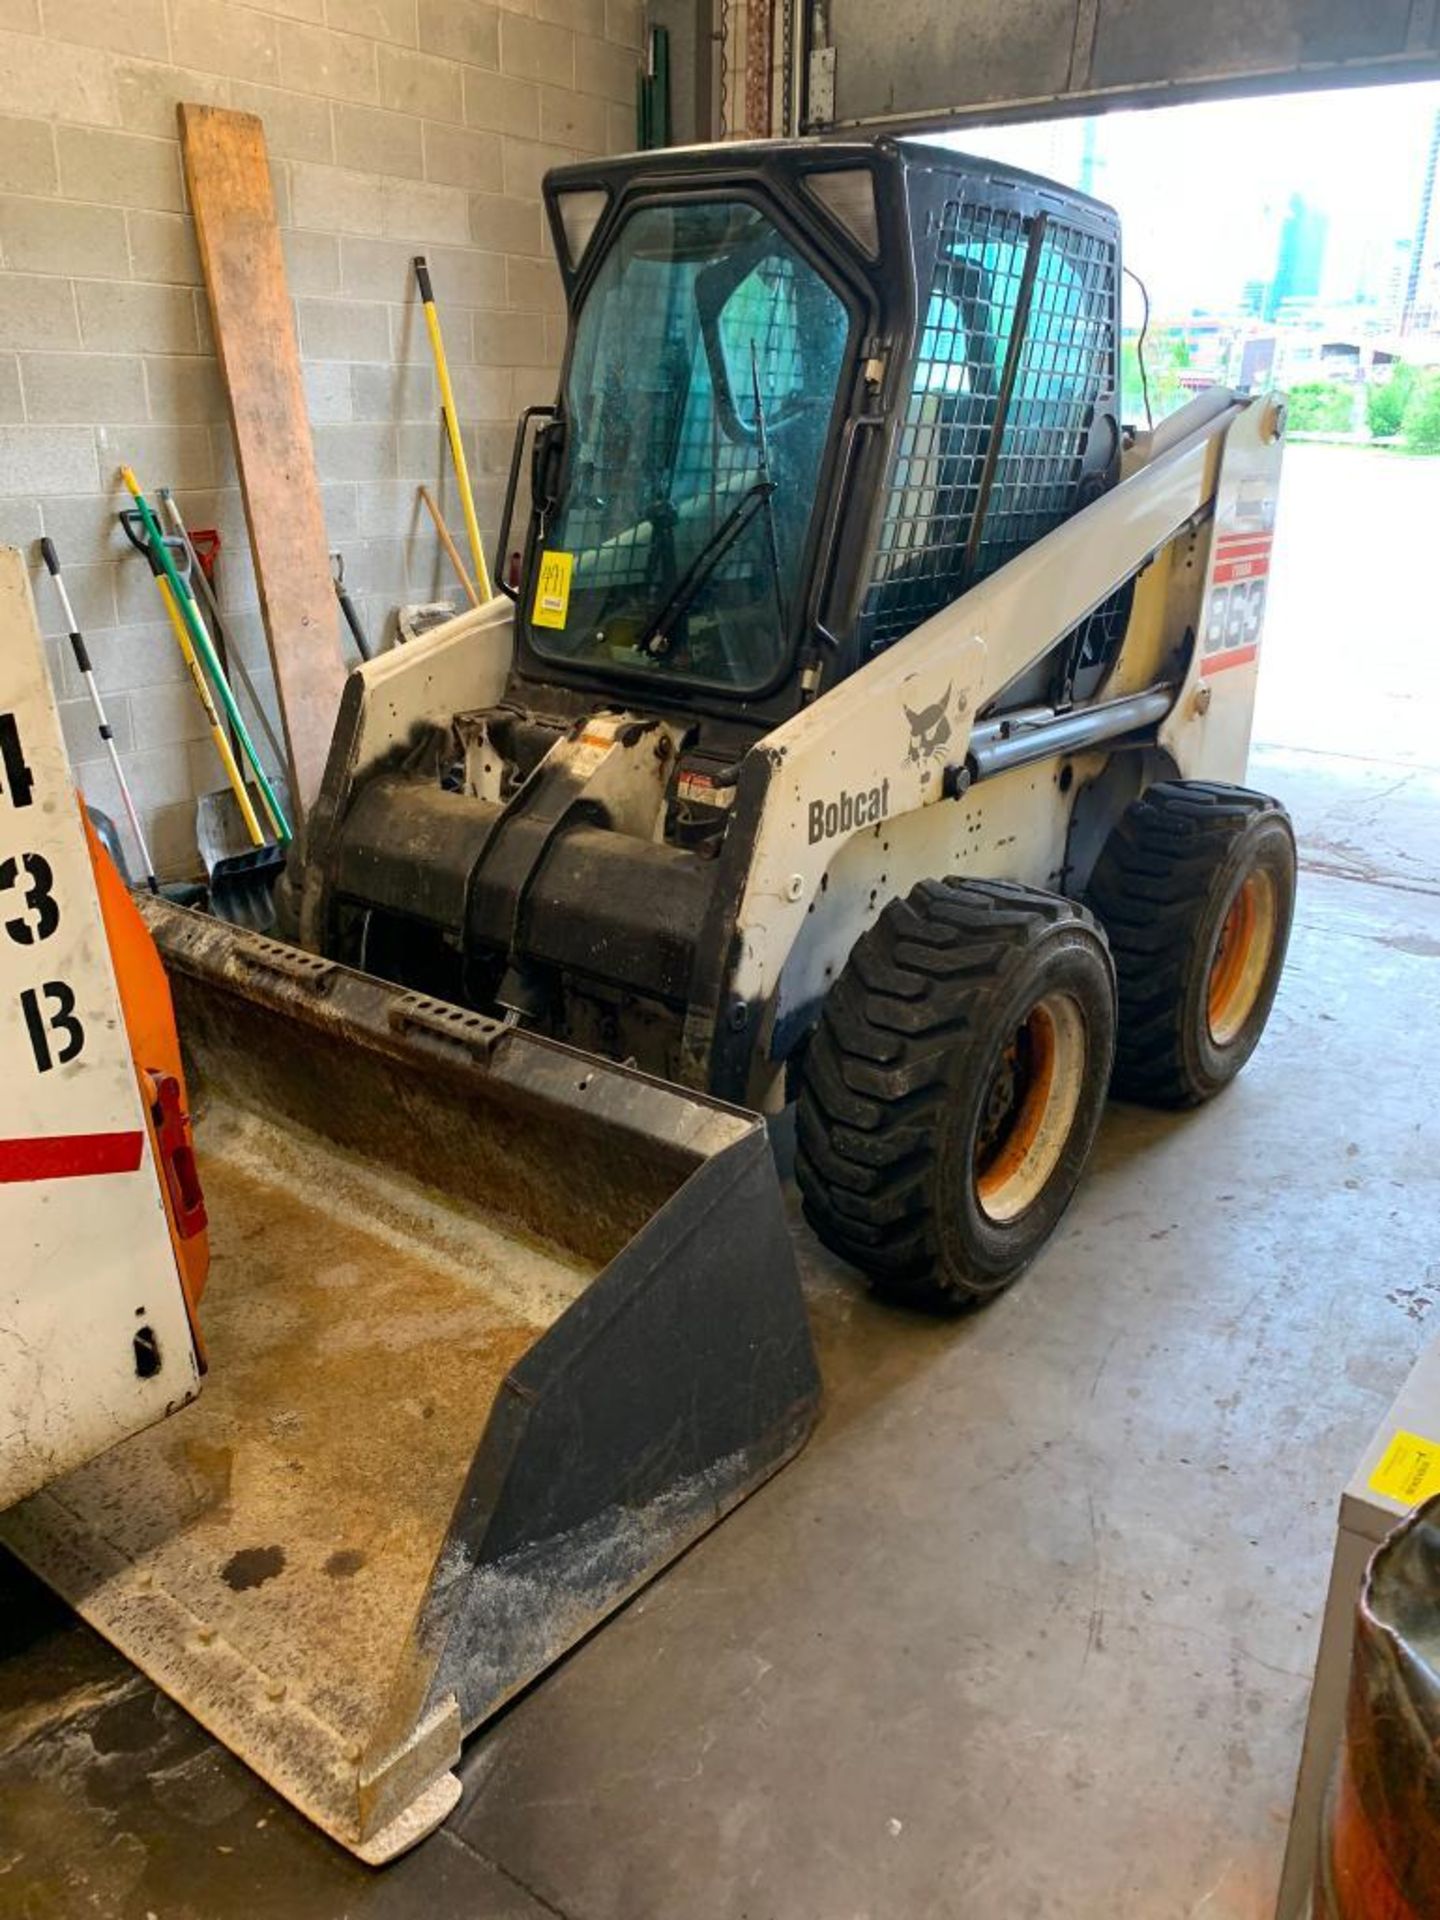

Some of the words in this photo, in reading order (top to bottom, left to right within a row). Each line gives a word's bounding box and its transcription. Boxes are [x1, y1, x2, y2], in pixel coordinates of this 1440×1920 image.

[1204, 579, 1266, 652] 863
[808, 778, 889, 845] Bobcat
[20, 981, 85, 1072] B
